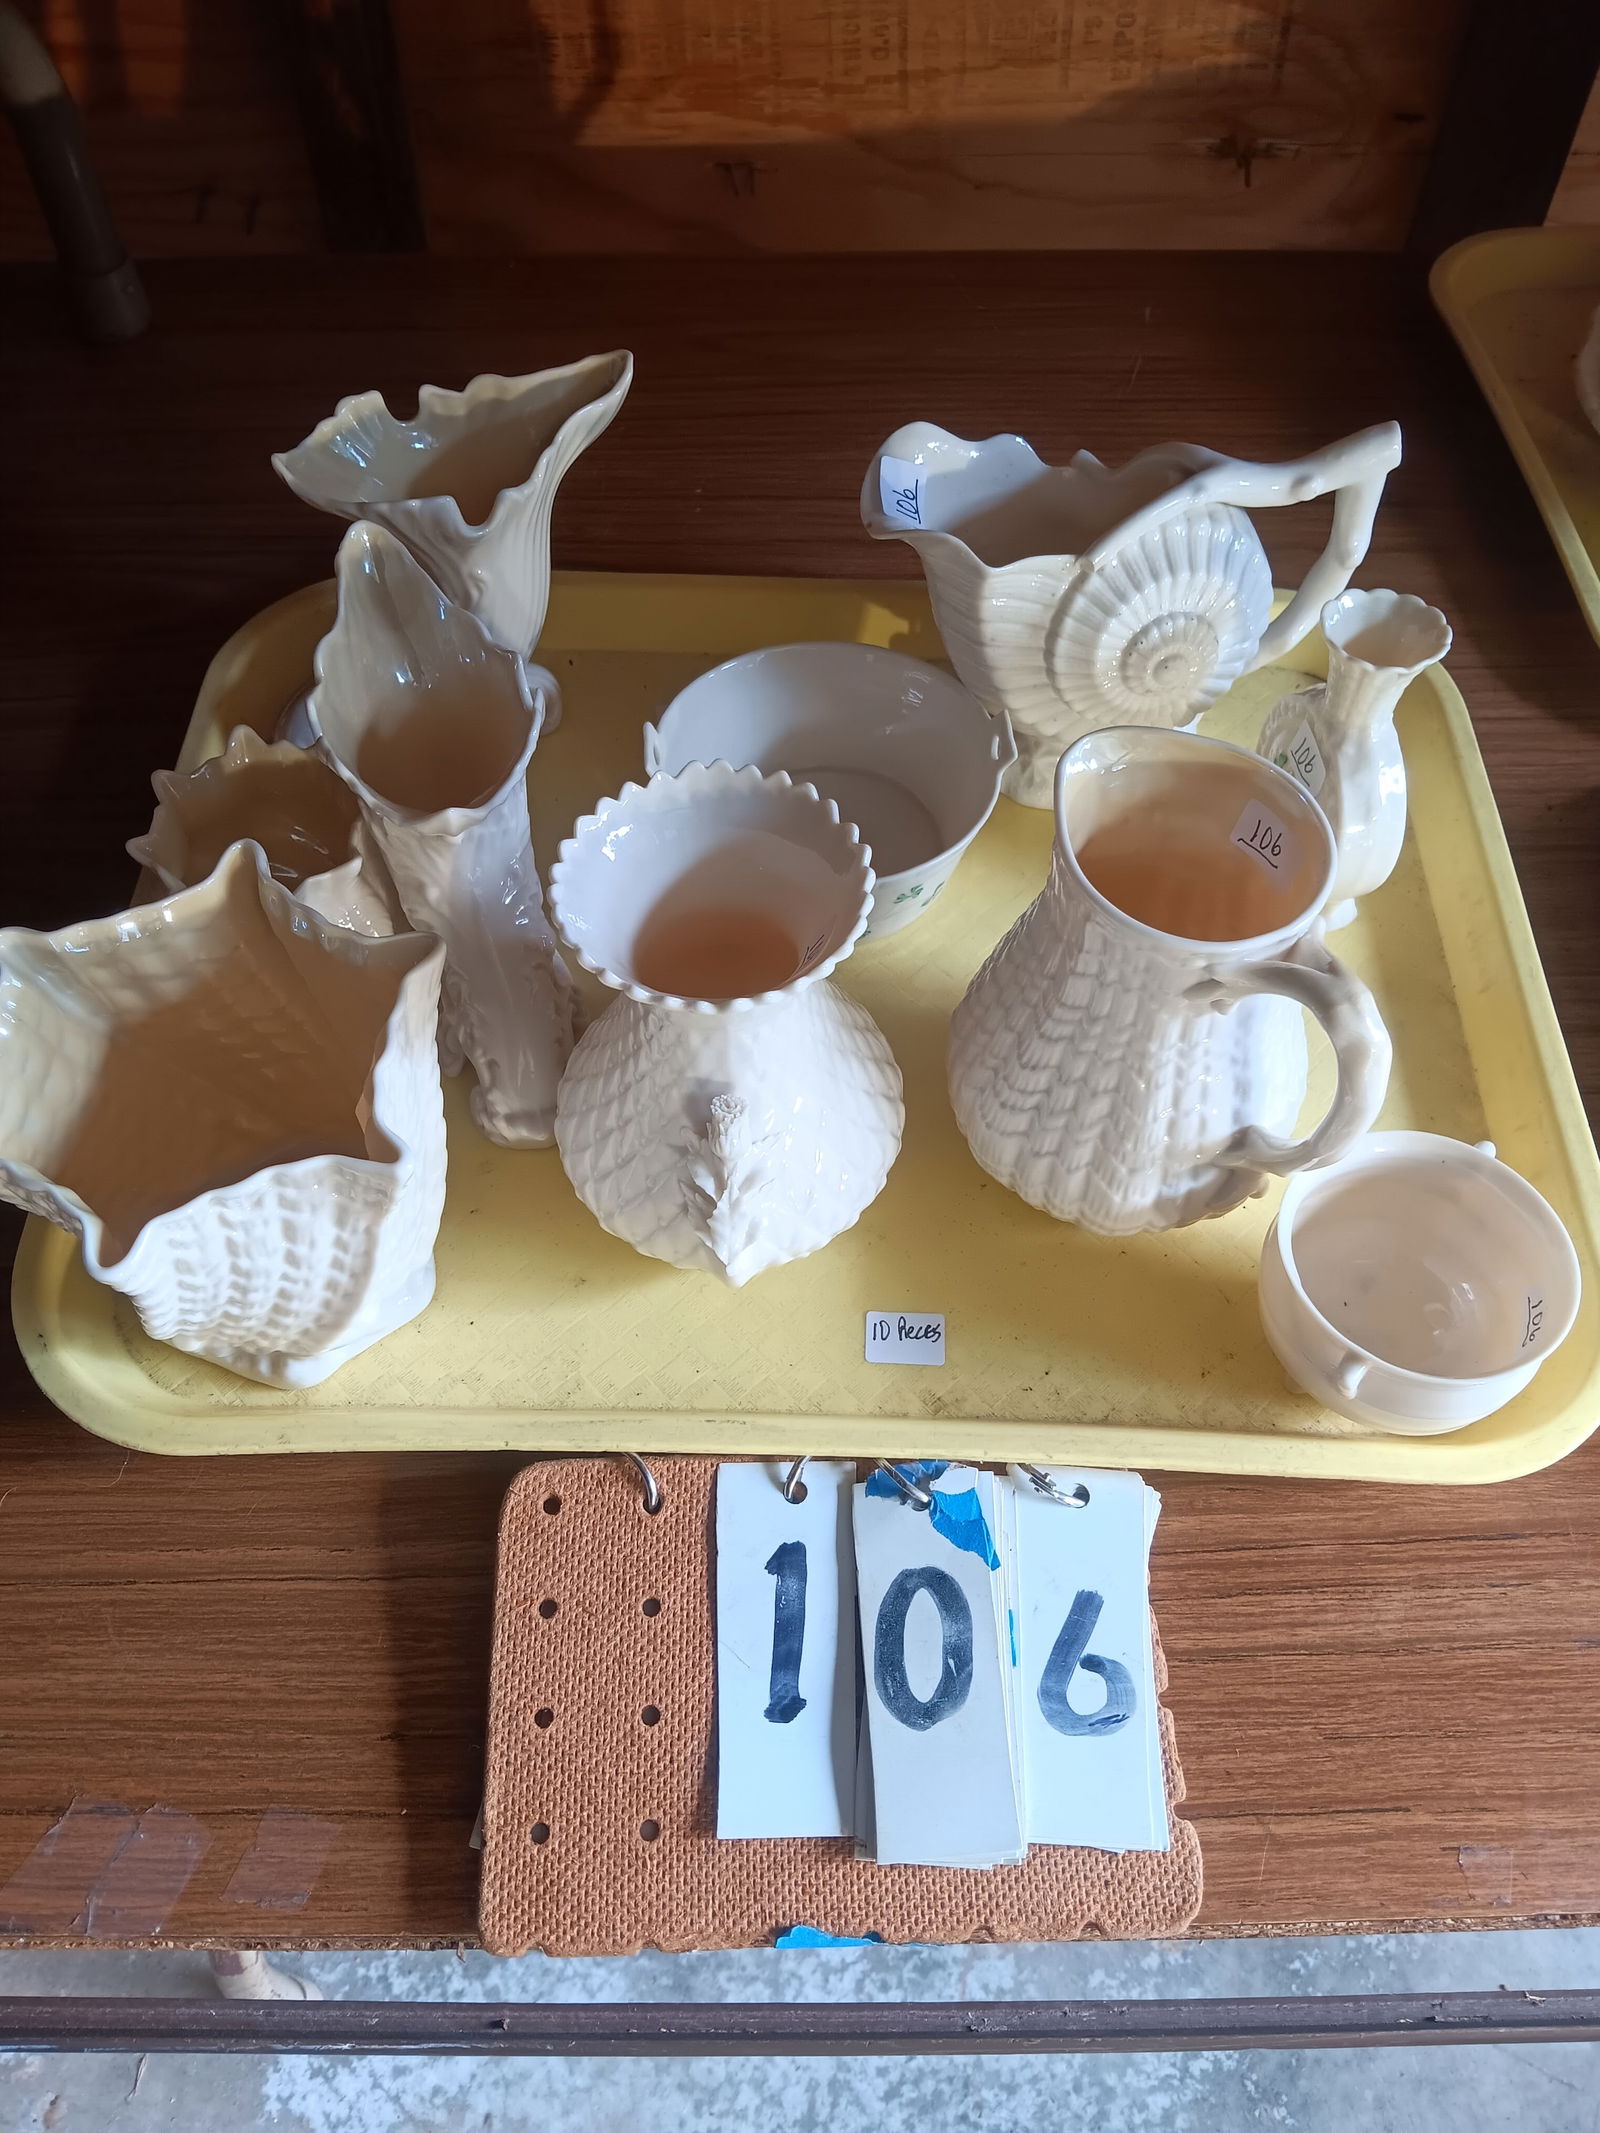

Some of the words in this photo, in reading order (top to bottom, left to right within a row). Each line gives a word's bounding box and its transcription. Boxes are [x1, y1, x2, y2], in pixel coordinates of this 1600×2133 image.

[892, 486, 919, 521] 106
[1294, 737, 1317, 774] 106
[1249, 819, 1283, 857] 106
[872, 1319, 891, 1341] 10
[1527, 1298, 1543, 1343] 106
